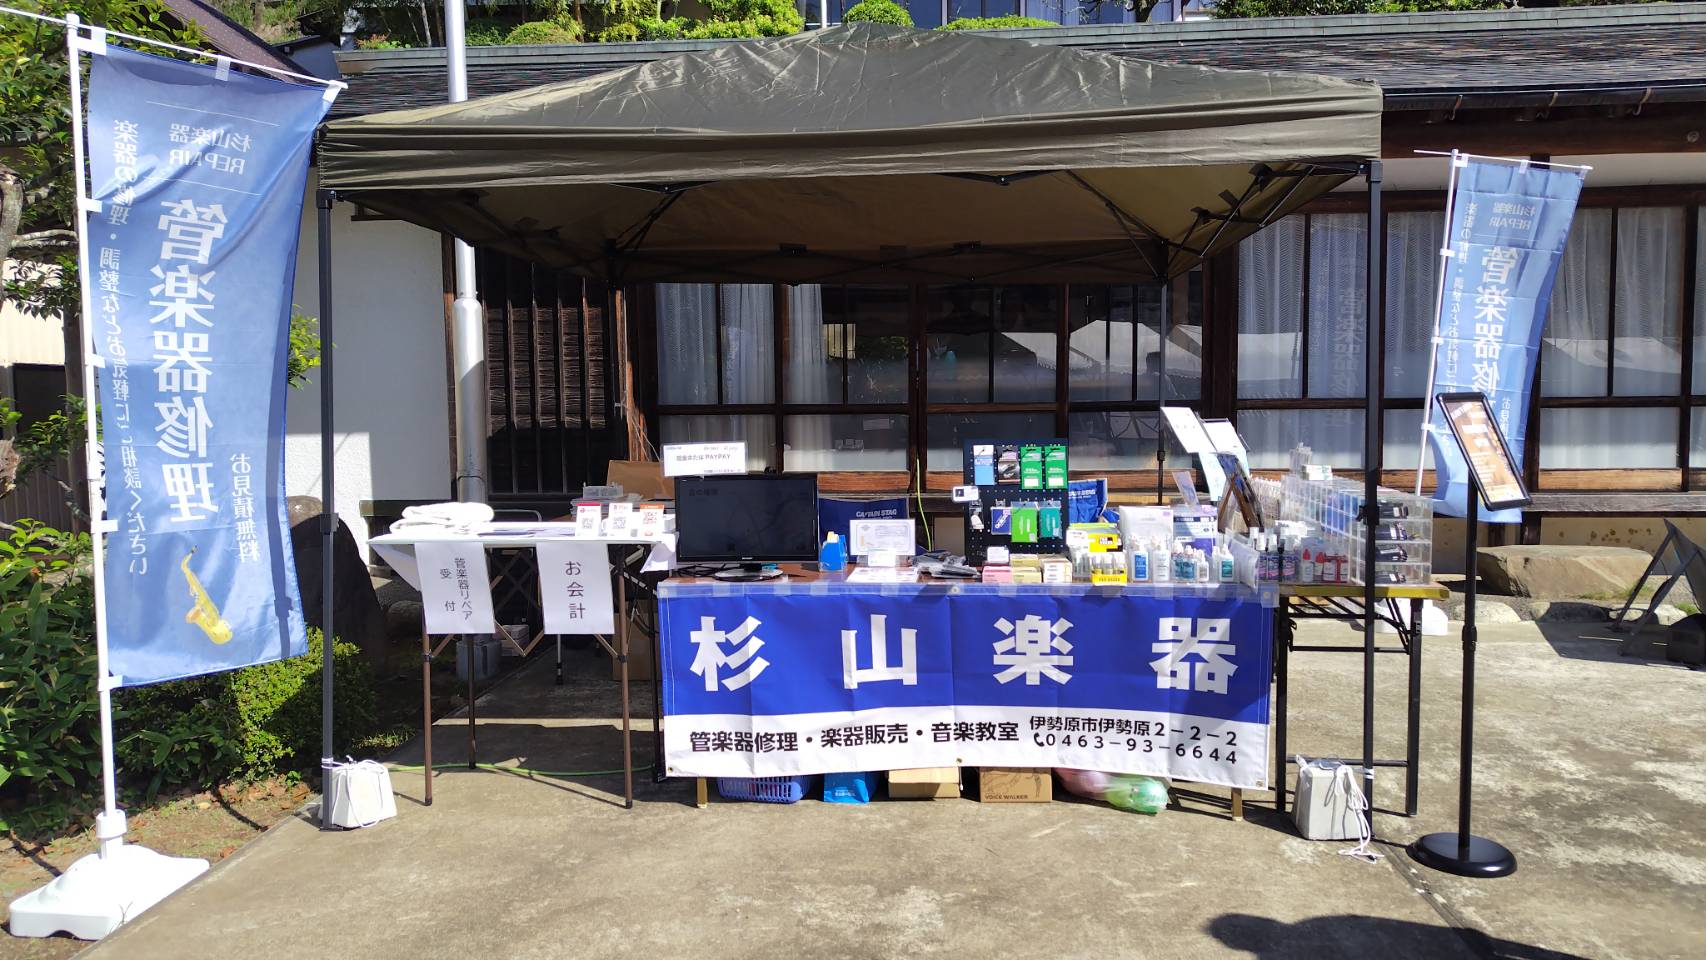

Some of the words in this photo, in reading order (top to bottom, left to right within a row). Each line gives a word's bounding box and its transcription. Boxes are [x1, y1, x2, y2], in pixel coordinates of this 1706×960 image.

[454, 557, 473, 621] 管楽器リペア
[565, 560, 586, 620] お会計
[690, 614, 1238, 695] 杉山楽器
[689, 721, 1020, 754] 管楽器修理・楽器販売・音楽教室
[1046, 732, 1238, 765] 0463-93-6644
